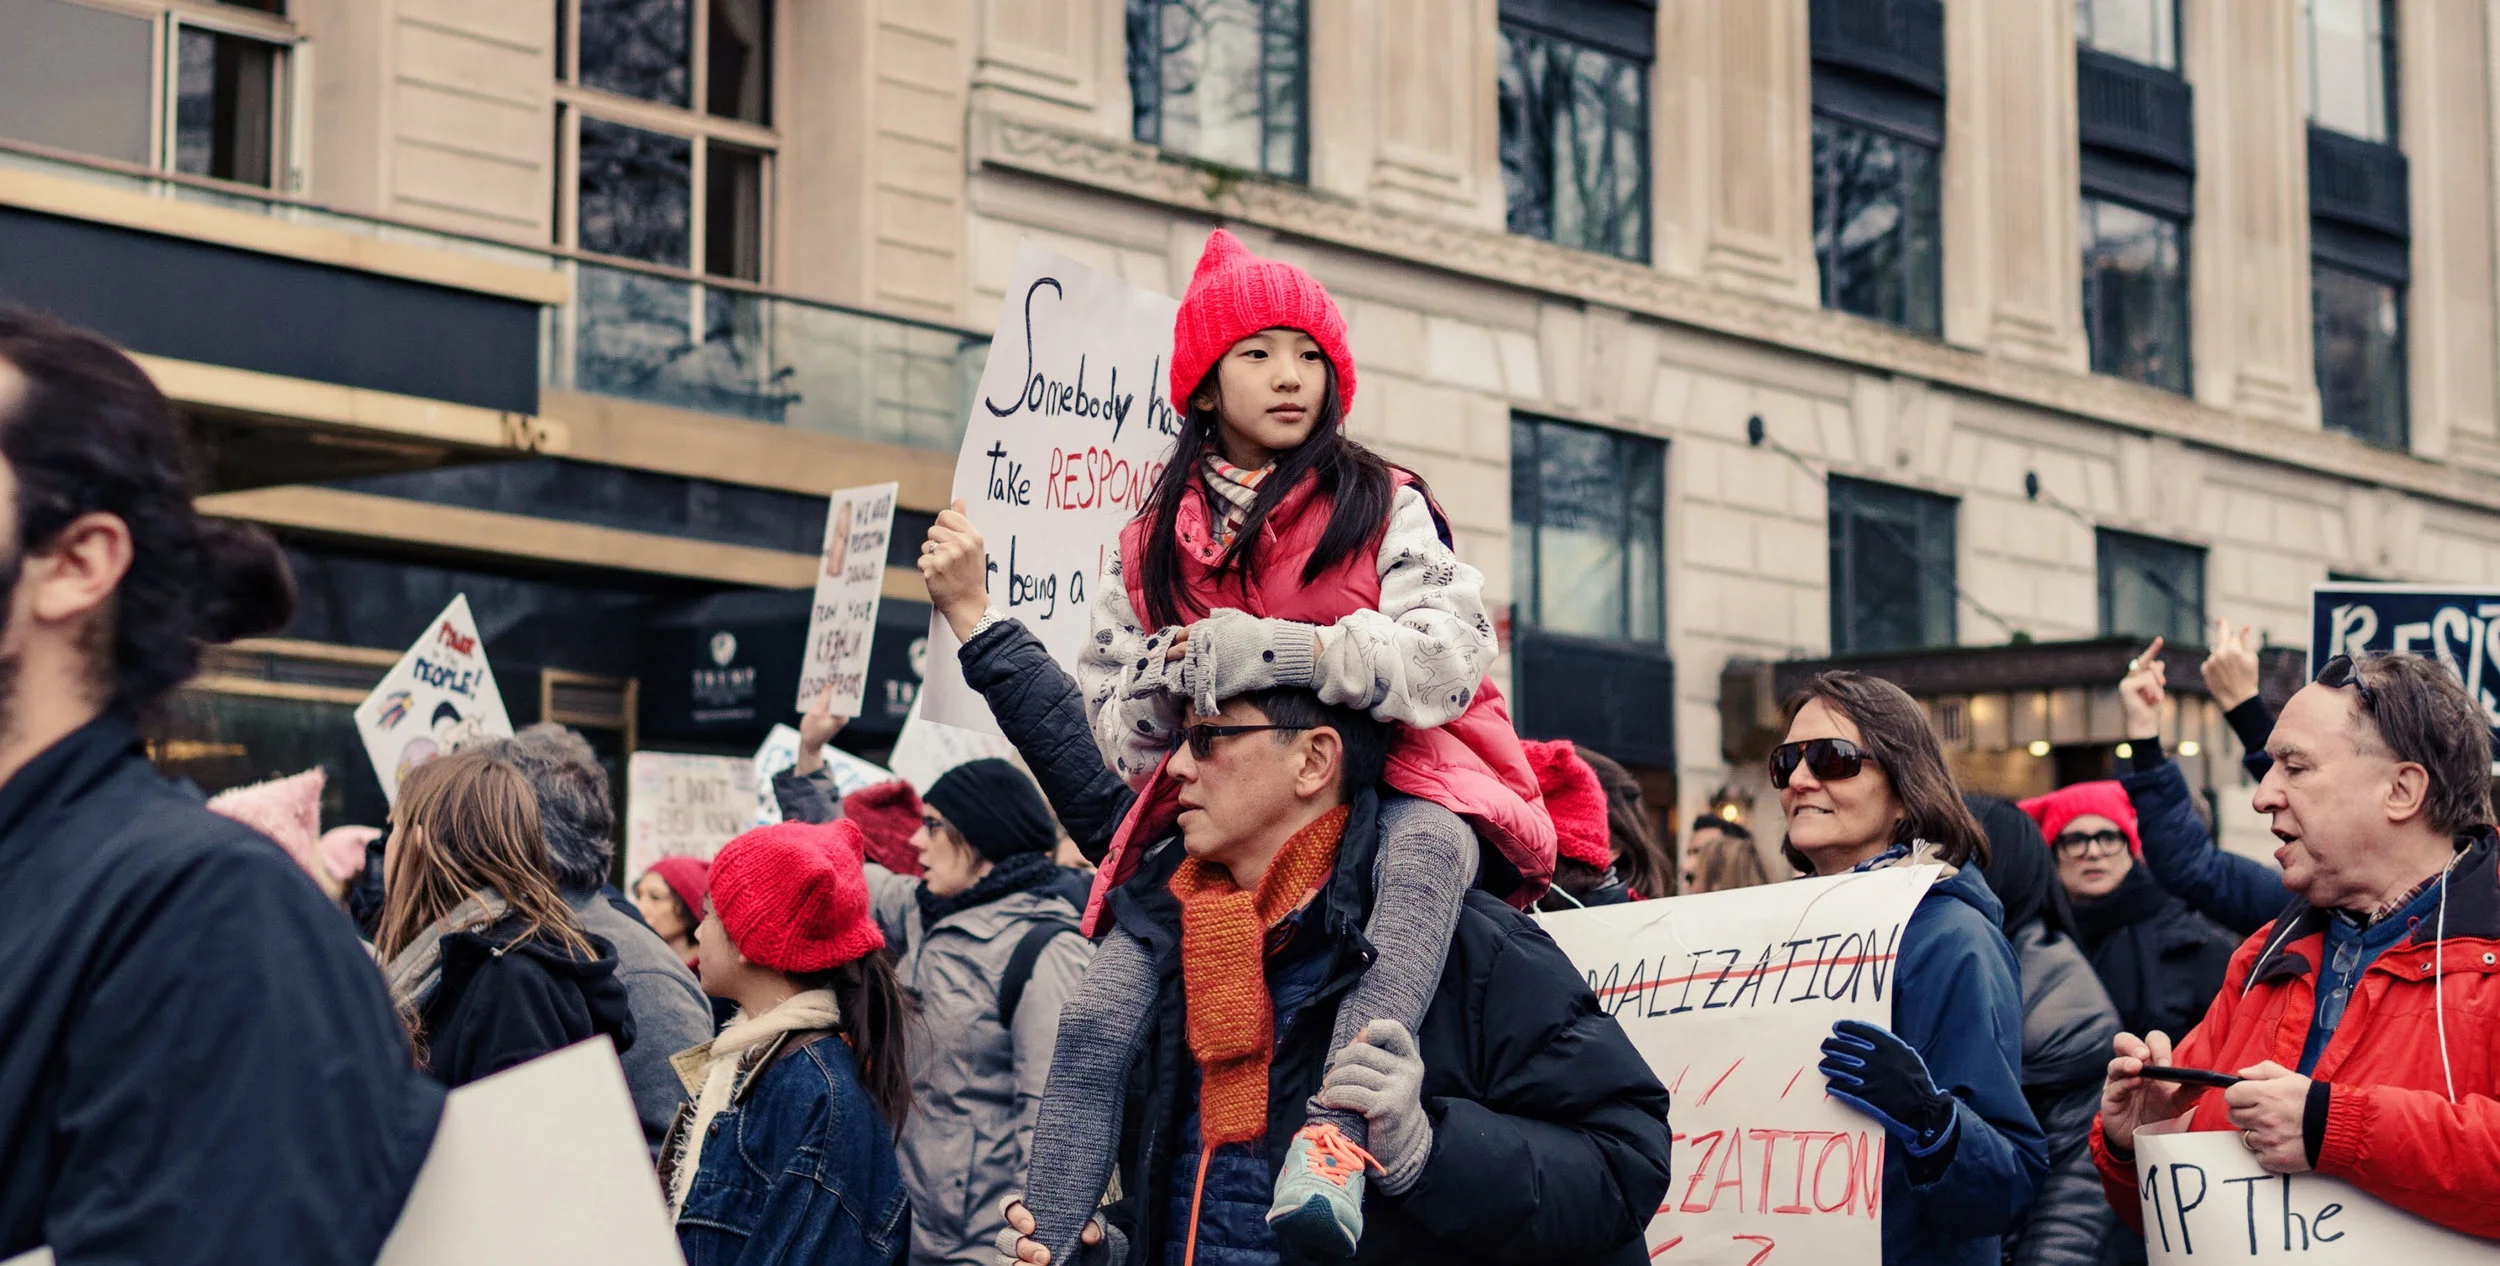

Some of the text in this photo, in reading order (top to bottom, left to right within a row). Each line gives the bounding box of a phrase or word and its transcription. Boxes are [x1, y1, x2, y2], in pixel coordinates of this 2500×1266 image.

[986, 277, 1133, 442] Somebody
[1009, 535, 1057, 620] being
[1070, 570, 1084, 605] a
[414, 657, 484, 701] PEOPLE!
[2223, 1172, 2345, 1256] The
